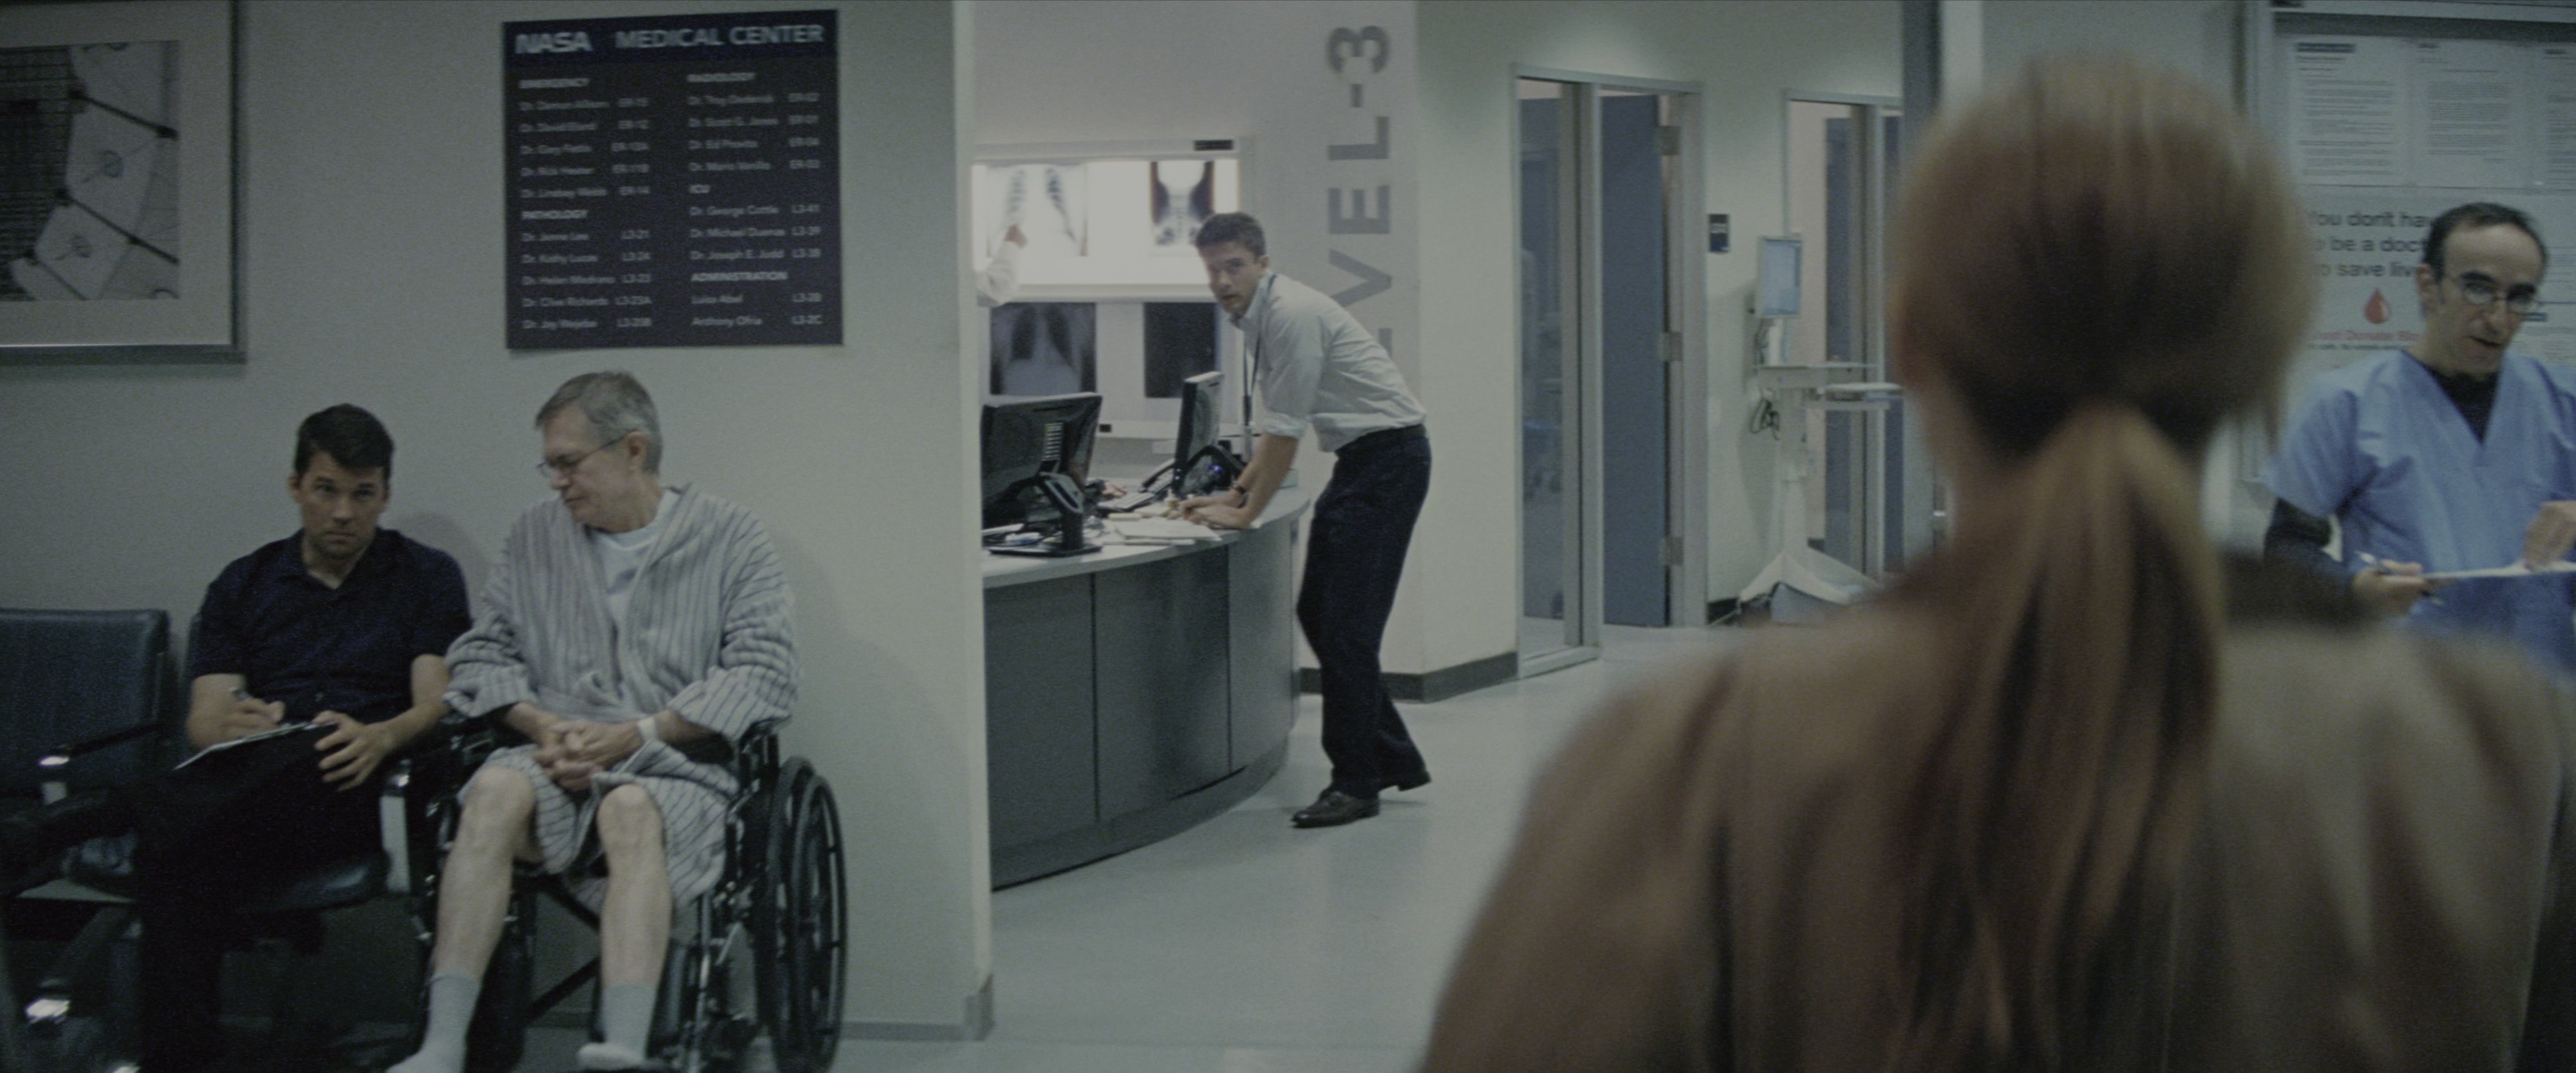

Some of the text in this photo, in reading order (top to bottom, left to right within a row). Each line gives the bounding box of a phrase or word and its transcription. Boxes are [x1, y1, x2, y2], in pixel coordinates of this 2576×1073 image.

[515, 24, 824, 54] NASA MEDICAL CENTER
[519, 77, 591, 89] EMERGENCY
[687, 72, 756, 83] RADIOLOGY
[688, 184, 710, 194] ICU
[1327, 24, 1393, 357] VEL-3
[521, 209, 588, 221] PATHOLOGY
[706, 205, 745, 219] George
[2399, 211, 2432, 229] hav
[706, 227, 745, 238] Michael
[2330, 235, 2357, 252] be
[2361, 239, 2375, 252] a
[2381, 236, 2423, 253] doc
[708, 249, 744, 262] Joseph
[690, 270, 788, 282] ADMINISTRATION
[2337, 264, 2385, 278] save
[2389, 261, 2416, 278] liv
